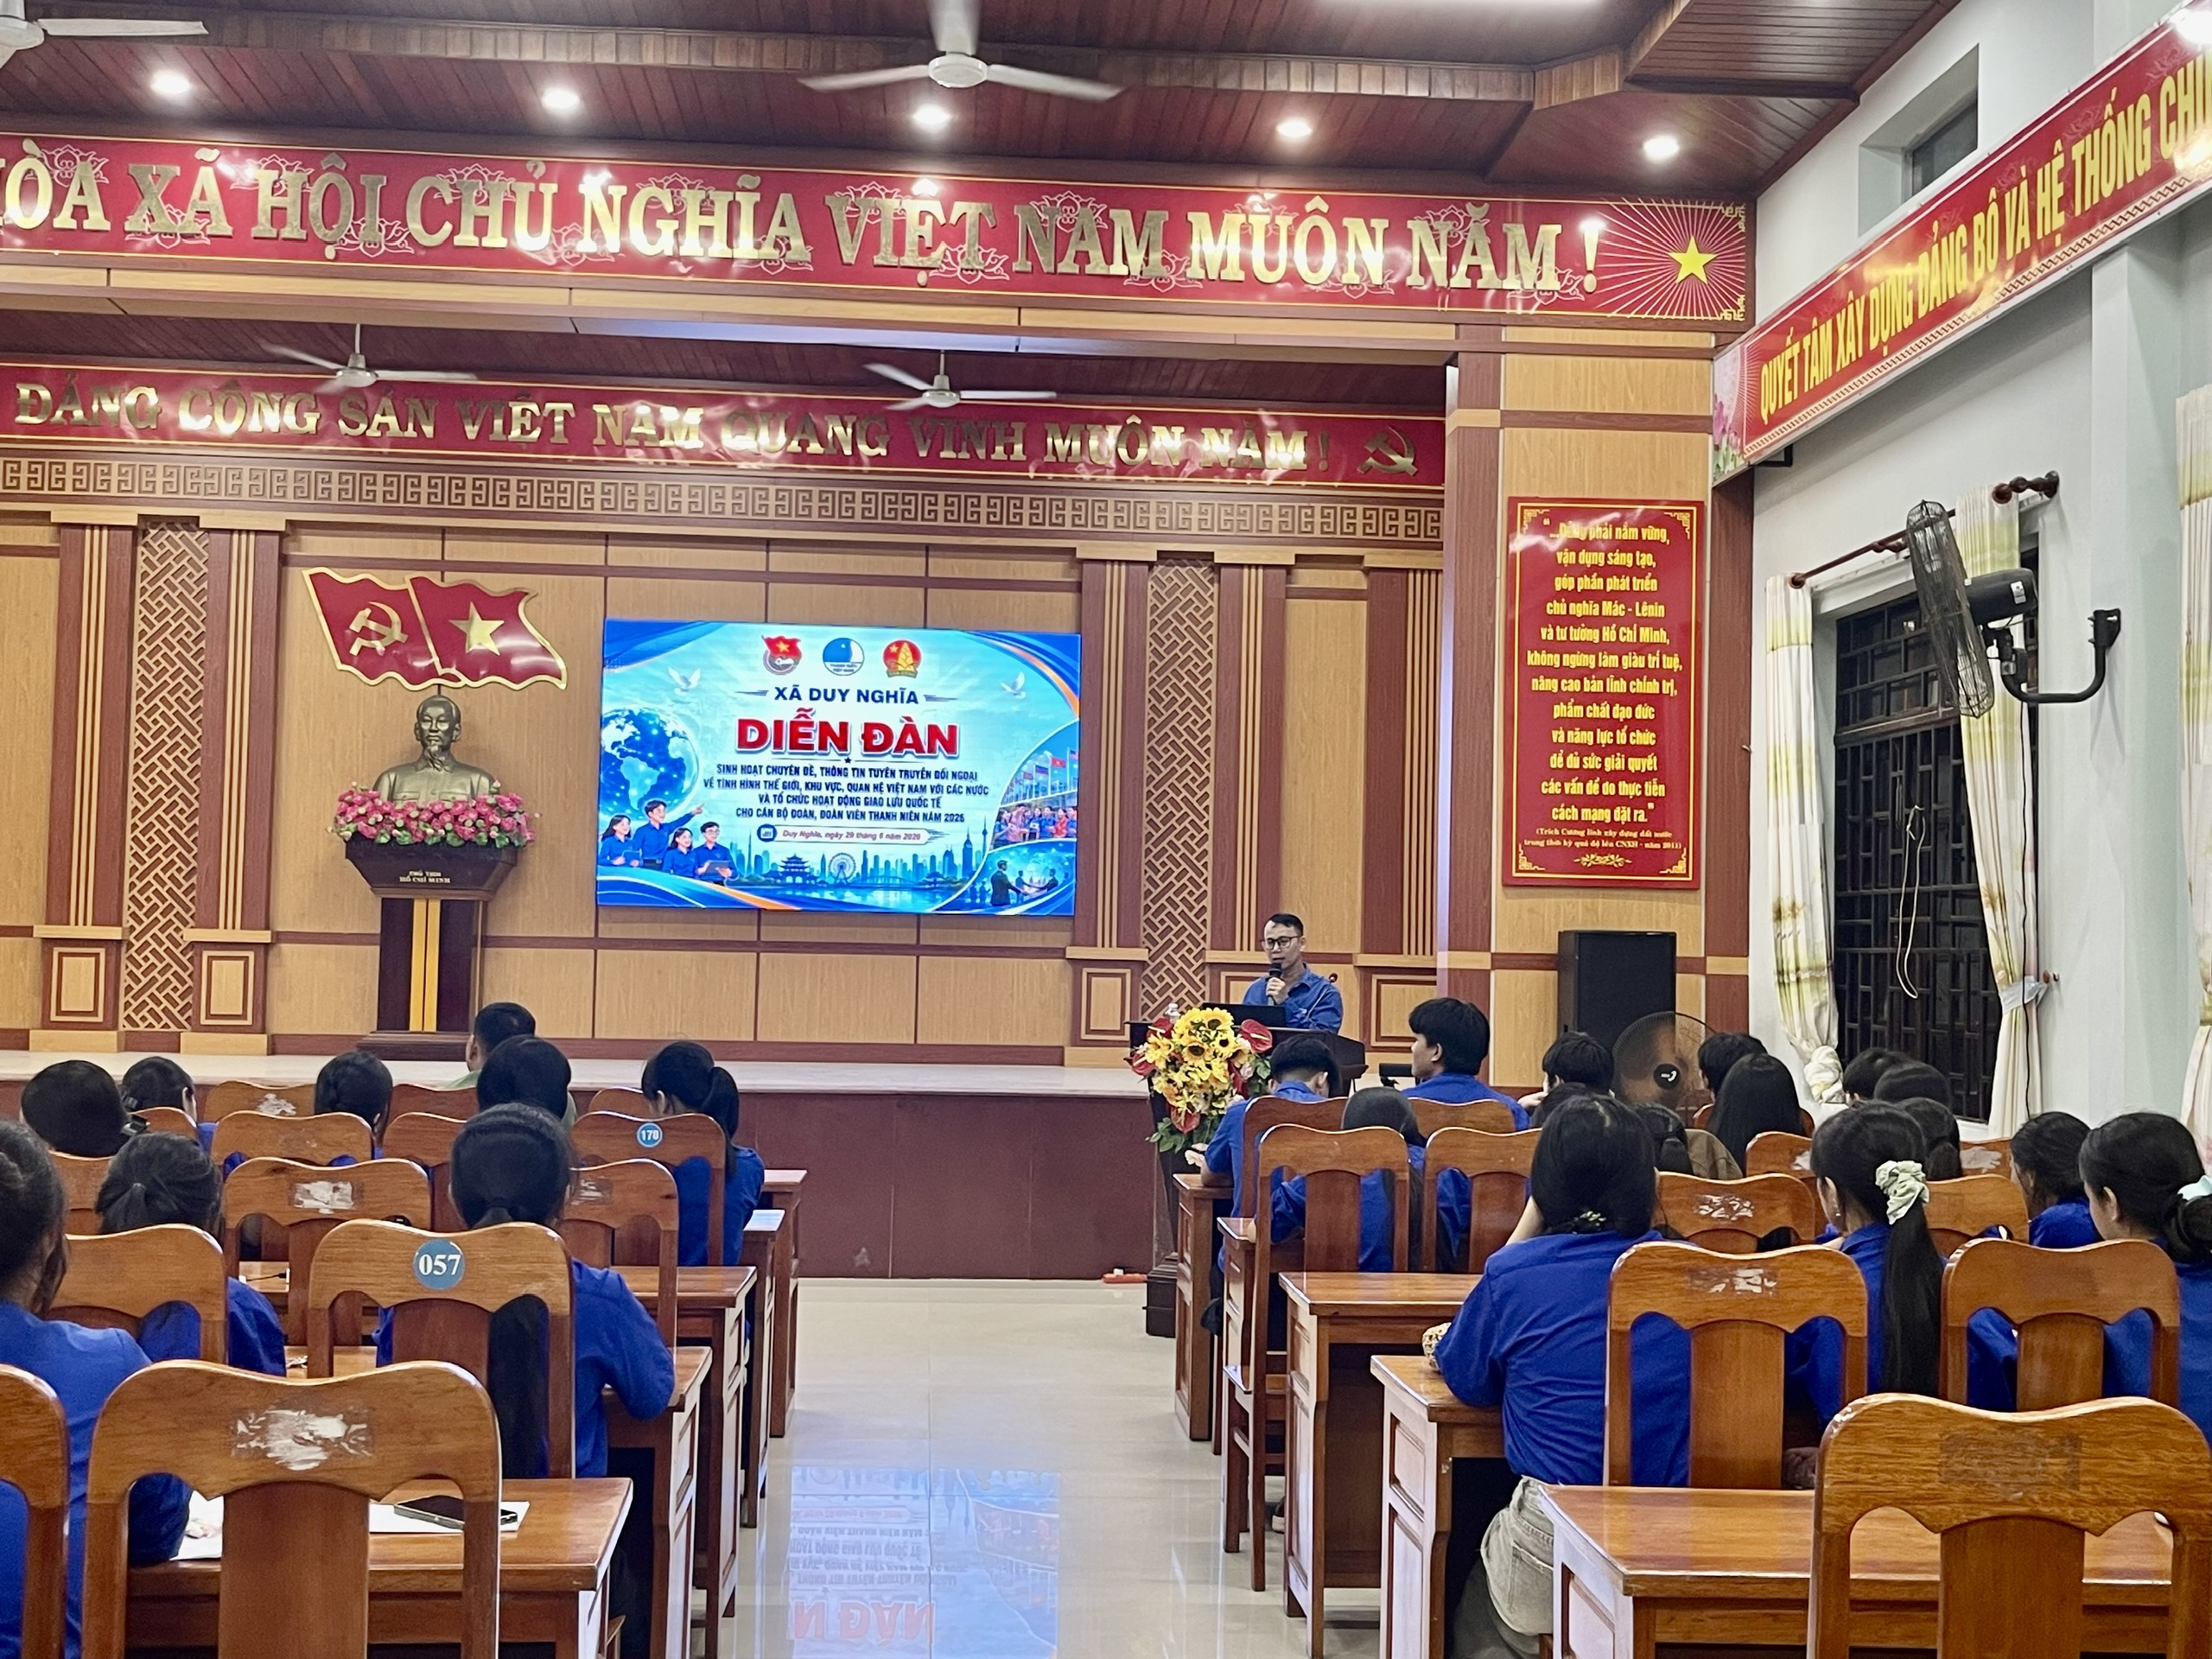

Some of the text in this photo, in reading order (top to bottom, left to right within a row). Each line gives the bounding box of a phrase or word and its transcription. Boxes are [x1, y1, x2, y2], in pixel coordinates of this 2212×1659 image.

[0, 138, 111, 232] ÒA
[124, 148, 233, 238] XÃ
[251, 152, 386, 260] HỘI
[405, 159, 558, 251] CHỦ
[576, 174, 811, 264] NGHĨA
[824, 178, 997, 286] VIỆT
[1013, 204, 1169, 278] NAM
[1187, 194, 1389, 286] MUÔN
[1406, 201, 1562, 291] NĂM
[1761, 327, 1800, 425] QUYẾT
[1803, 316, 1832, 392] TÂM
[1836, 290, 1866, 372] XÂY
[1918, 220, 1967, 319] ĐẢNG
[2004, 164, 2031, 260] VÀ
[2036, 138, 2065, 247] HỆ
[2071, 86, 2152, 218] THỐNG
[15, 371, 162, 429] ĐẢNG
[338, 385, 438, 438] SẢN
[455, 390, 575, 448] VIỆT
[592, 403, 704, 448] NAM
[721, 412, 892, 456] QUANG
[909, 416, 1027, 461] VINH
[1044, 415, 1185, 466] MUÔN
[1200, 418, 1307, 470] NĂM
[1557, 549, 1656, 568] vận dụng sáng tạo,
[1554, 574, 1574, 591] góp
[1606, 575, 1630, 592] phát
[1632, 573, 1657, 591] triển
[1547, 598, 1567, 615] chủ
[1569, 601, 1599, 617] nghĩa
[1602, 600, 1625, 616] Mác
[1636, 601, 1665, 617] Lênin
[1541, 624, 1669, 645] và tư tưởng Hồ Chí Minh,
[1528, 650, 1682, 671] không ngừng làm giàu trí tuệ,
[774, 683, 918, 704] XÃ DUY NGHĨA
[1532, 675, 1677, 696] nâng cao bản lĩnh chính trị,
[1554, 698, 1584, 719] phẩm
[1586, 701, 1610, 718] chất
[1635, 703, 1655, 719] đức
[736, 707, 958, 756] DIỄN ĐÀN
[1552, 725, 1656, 747] và năng lực tổ chức
[1567, 752, 1580, 768] đủ
[1583, 753, 1602, 769] sức
[1605, 753, 1624, 772] giải
[1628, 753, 1657, 772] quyết
[716, 764, 978, 783] SINH HOẠT CHUYÊN ĐỀ, THÔNG TIN TUYÊN TRUYỀN ĐỐI NGOẠI
[703, 777, 989, 797] VỀ TÌNH HÌNH THẾ GIỚI, KHU VỰC, QUAN HỆ VIỆT NAM VỚI CÁC NƯỚC
[1541, 778, 1561, 794] các
[1564, 777, 1583, 794] vấn
[1602, 781, 1615, 795] do
[1618, 781, 1642, 798] thực
[1644, 779, 1665, 797] tiễn
[759, 791, 943, 809] VÀ TỔ CHỨC HOẠT ĐỘNG GIAO LƯU QUỐC TẾ
[736, 807, 965, 823] CHO CÁN BỘ ĐOÀN, ĐOÀN VIÊN THANH NIÊN NĂM 2026
[1552, 804, 1579, 820] cách
[1581, 808, 1611, 823] mạng
[1614, 806, 1630, 824] đặt
[418, 1254, 461, 1275] 057
